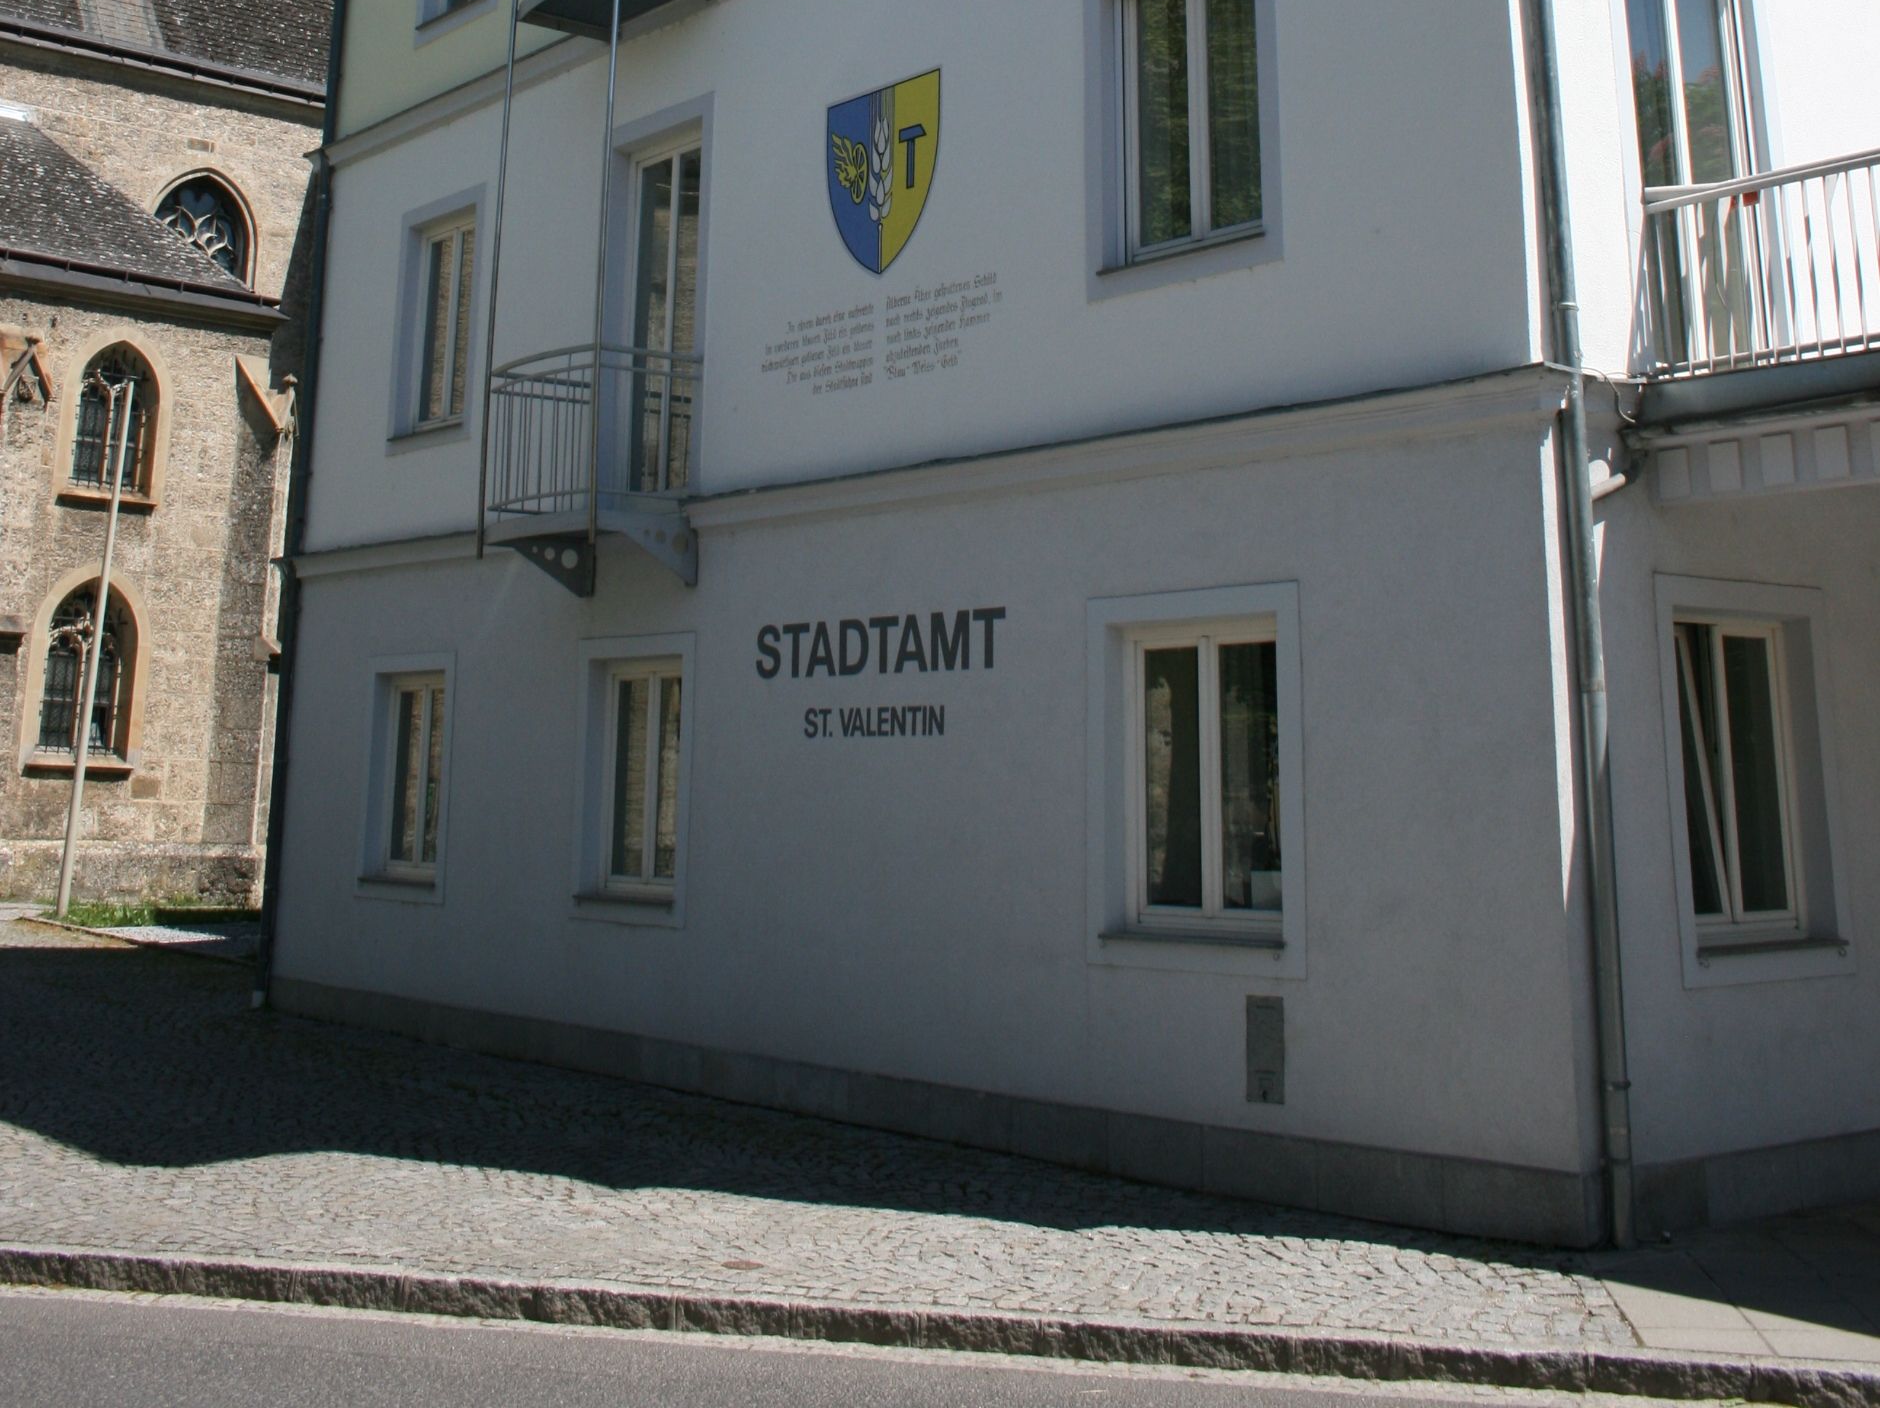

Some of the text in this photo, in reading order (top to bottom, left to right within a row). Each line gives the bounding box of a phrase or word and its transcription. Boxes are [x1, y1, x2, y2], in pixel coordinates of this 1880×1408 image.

[755, 606, 1006, 680] STADTAMT
[804, 705, 945, 739] ST. VALENTIN
